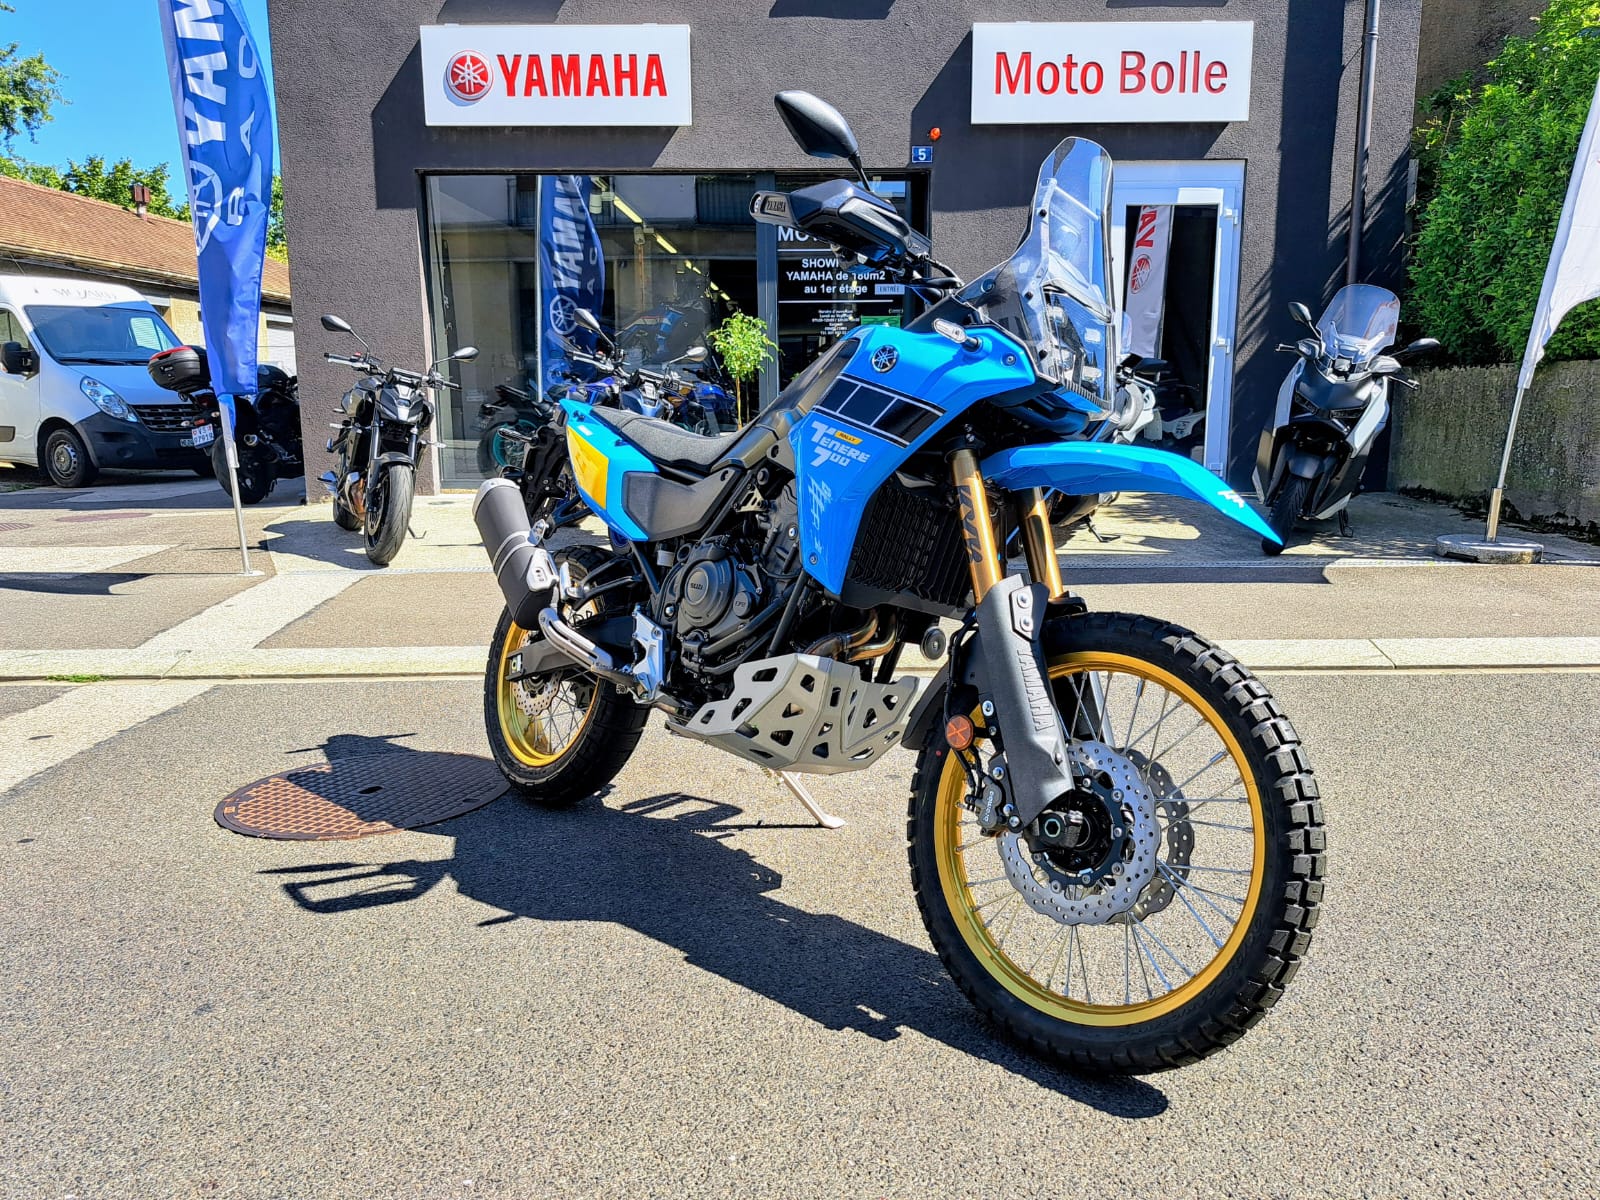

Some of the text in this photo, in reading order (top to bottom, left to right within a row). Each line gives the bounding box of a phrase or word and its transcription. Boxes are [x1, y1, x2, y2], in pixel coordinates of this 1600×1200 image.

[496, 53, 668, 97] YAMAHA
[994, 50, 1228, 95] Moto Bolle
[918, 148, 927, 161] 5
[786, 271, 833, 281] YAMAHA
[836, 271, 849, 281] de
[804, 283, 868, 296] au 1er étage
[810, 445, 851, 467] 700
